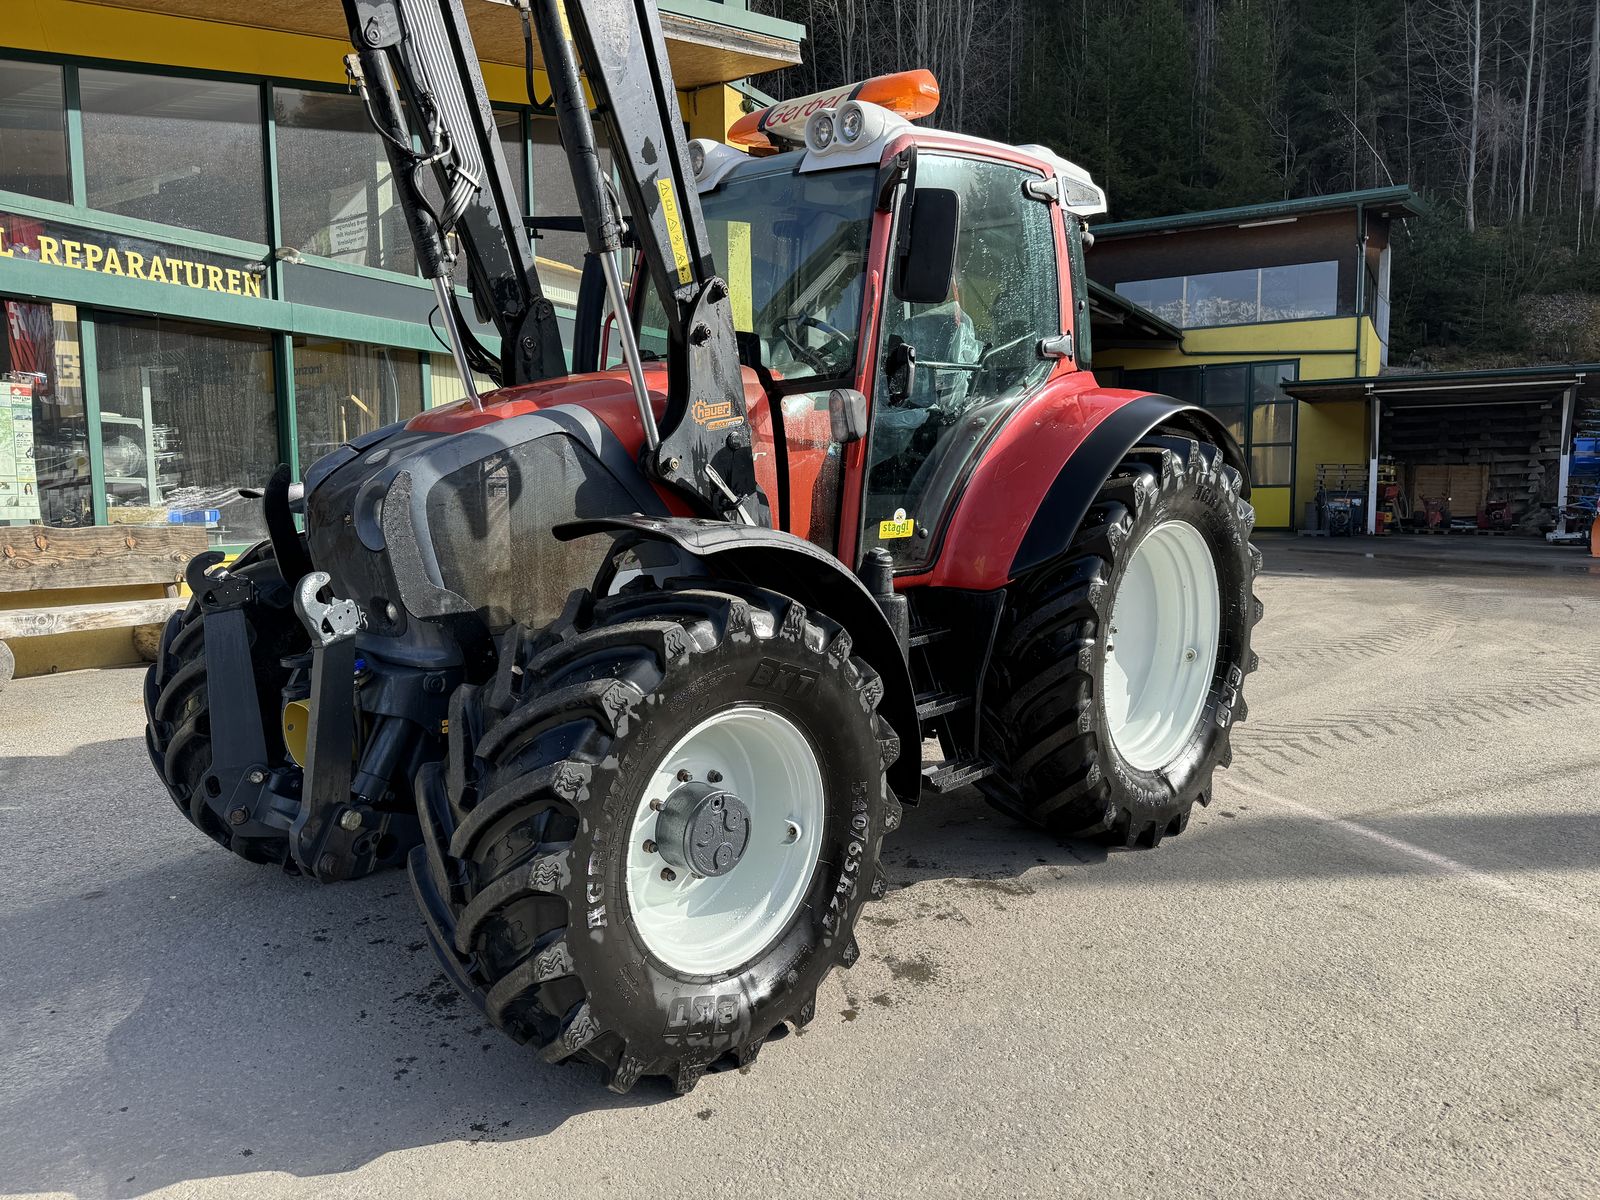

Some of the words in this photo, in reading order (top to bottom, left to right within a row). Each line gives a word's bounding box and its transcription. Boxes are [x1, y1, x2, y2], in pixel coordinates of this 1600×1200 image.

[766, 93, 850, 127] Gerber
[37, 235, 262, 299] REPARATUREN
[697, 404, 730, 418] hauer
[821, 780, 868, 930] 540/65R24
